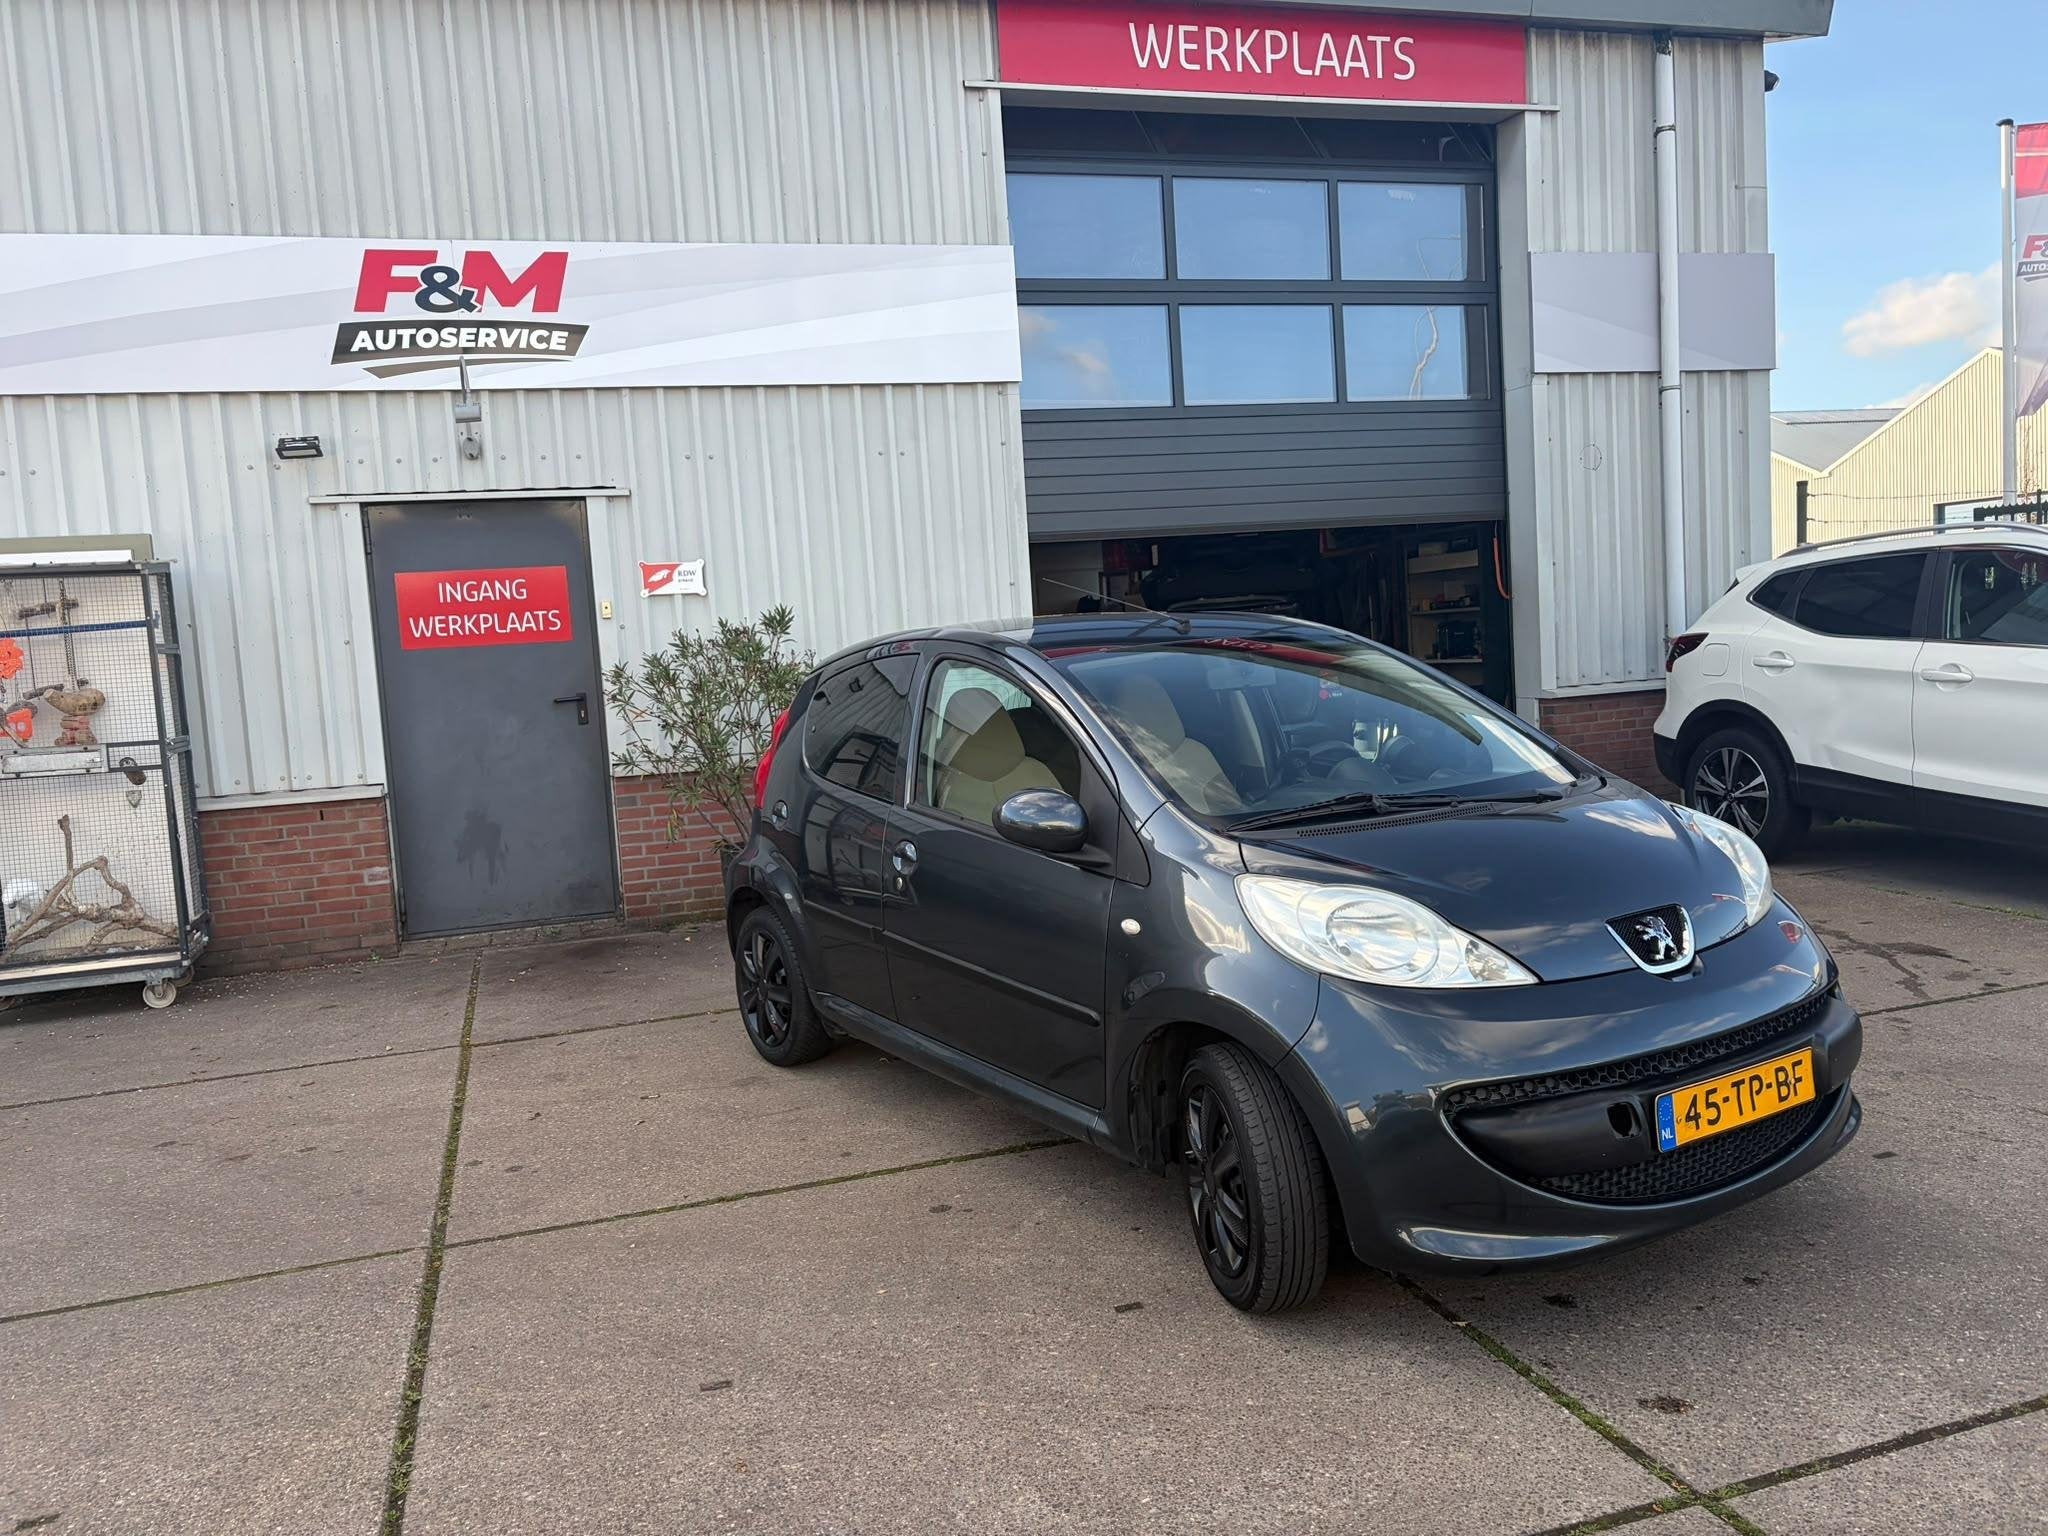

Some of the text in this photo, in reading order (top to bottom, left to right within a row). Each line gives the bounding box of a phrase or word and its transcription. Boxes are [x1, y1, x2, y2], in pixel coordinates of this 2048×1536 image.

[1129, 22, 1416, 80] WERKPLAATS
[354, 249, 569, 313] F&M
[350, 327, 569, 352] AUTOSERVICE
[438, 578, 527, 604] INGANG
[408, 610, 562, 639] WERKPLAATS
[1685, 1059, 1804, 1131] 45-TP-BF
[1661, 1127, 1674, 1141] NL
